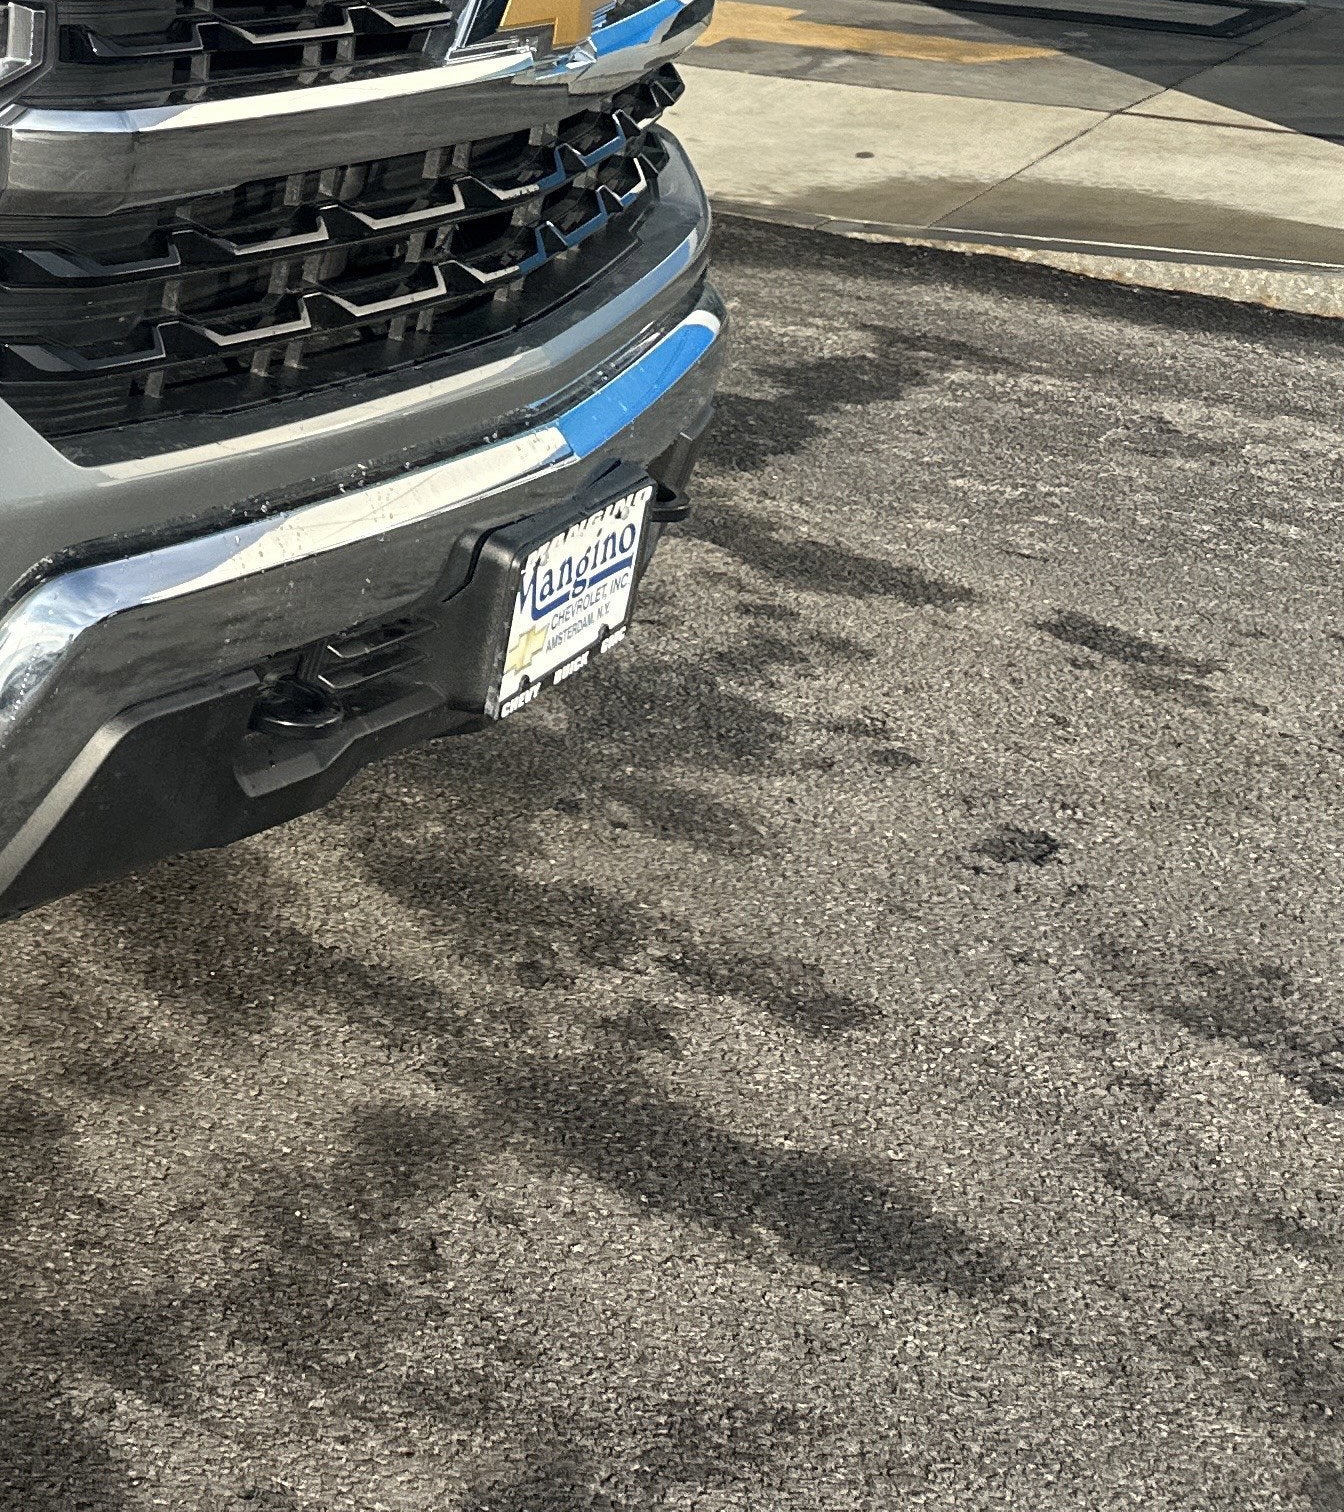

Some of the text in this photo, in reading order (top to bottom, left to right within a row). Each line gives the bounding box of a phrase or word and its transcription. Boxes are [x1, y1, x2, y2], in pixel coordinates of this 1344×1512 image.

[519, 523, 637, 615] Mangino
[500, 682, 542, 718] CHEVY
[553, 650, 590, 686] BUICK
